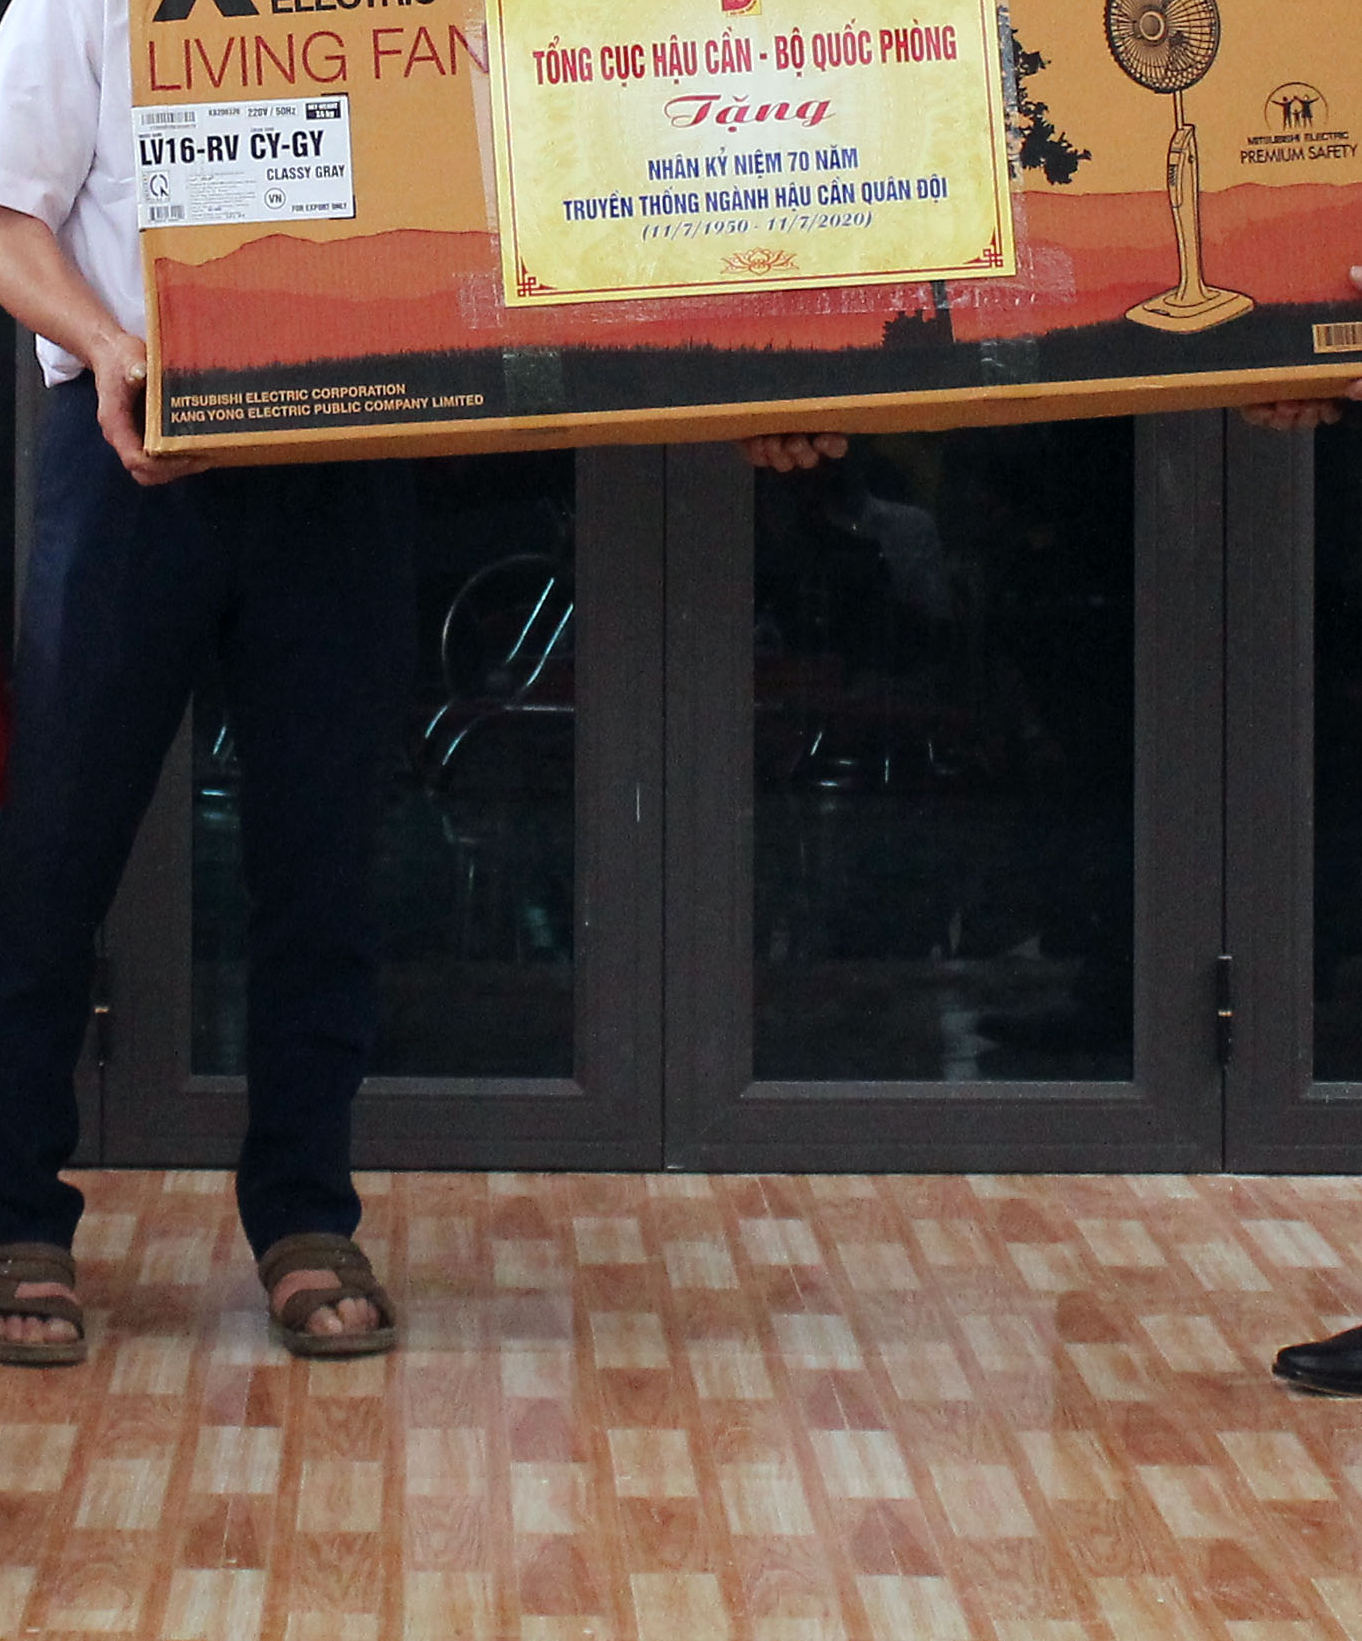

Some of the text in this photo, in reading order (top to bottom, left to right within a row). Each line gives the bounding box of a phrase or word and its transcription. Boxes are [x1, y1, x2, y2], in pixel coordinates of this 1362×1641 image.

[148, 24, 489, 91] LIVING FAN
[533, 35, 593, 85] TỔNG
[600, 44, 646, 87] CỤC
[652, 34, 698, 84] HẬU
[705, 26, 753, 75] CẦN
[774, 27, 805, 77] BỘ
[812, 18, 873, 72] QUỐC
[879, 18, 957, 64] PHÒNG
[664, 94, 836, 133] Tặng
[139, 130, 325, 166] LV16-RV CY-GY
[648, 144, 859, 181] NHÂN KỶ NIỆM 70 NĂM
[1240, 143, 1359, 164] PREMIUM SAFETY
[266, 164, 346, 181] CLASSY GRAY
[268, 193, 283, 204] VN
[563, 173, 948, 221] TRUYỀN THỐNG NGÀNH HẬU CẦN QUÂN ĐỘI
[642, 219, 750, 241] (11/7/1950
[767, 210, 873, 234] 11/7/2020)
[170, 383, 406, 408] MITSUBISHI ELECTRIC CORPORATION
[170, 394, 484, 424] KANG YONG ELECTRIC PUBLIC COMPANY LIMITED
